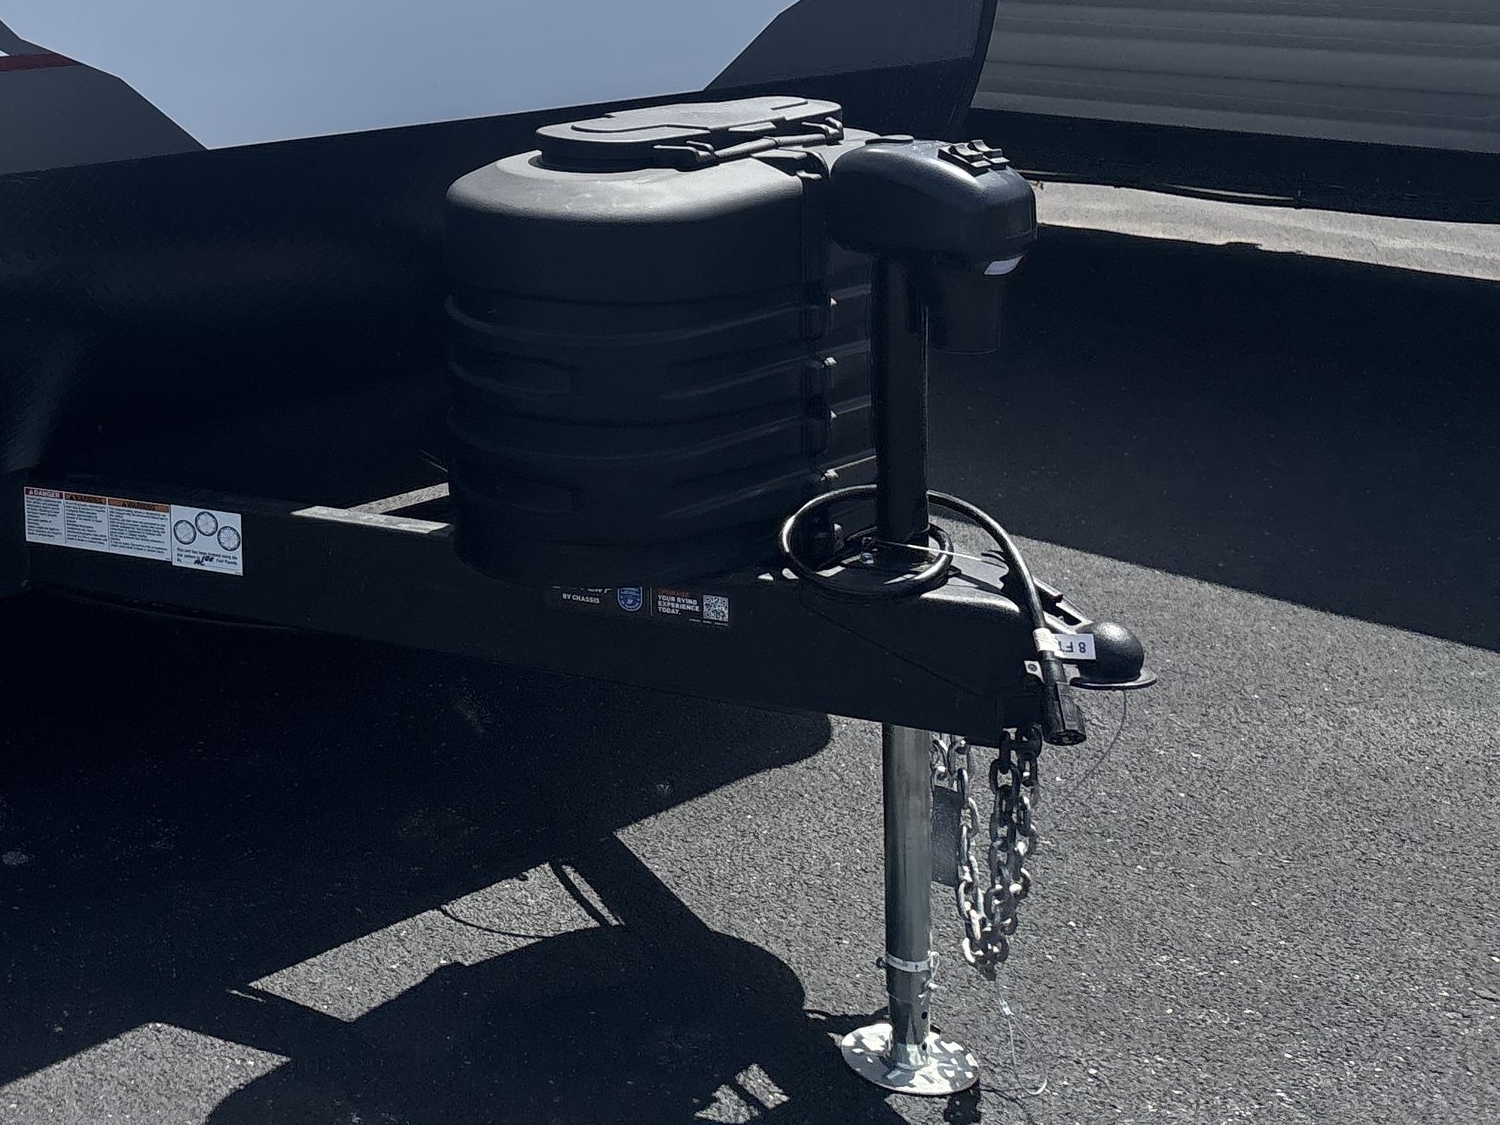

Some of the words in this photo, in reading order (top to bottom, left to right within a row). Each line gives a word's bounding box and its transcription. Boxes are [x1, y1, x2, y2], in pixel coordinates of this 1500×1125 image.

[572, 594, 601, 604] CHASSIS
[657, 594, 676, 603] YOUR
[676, 597, 698, 605] RVING
[657, 600, 700, 612] EXPERIENCE
[1078, 641, 1086, 653] 8
